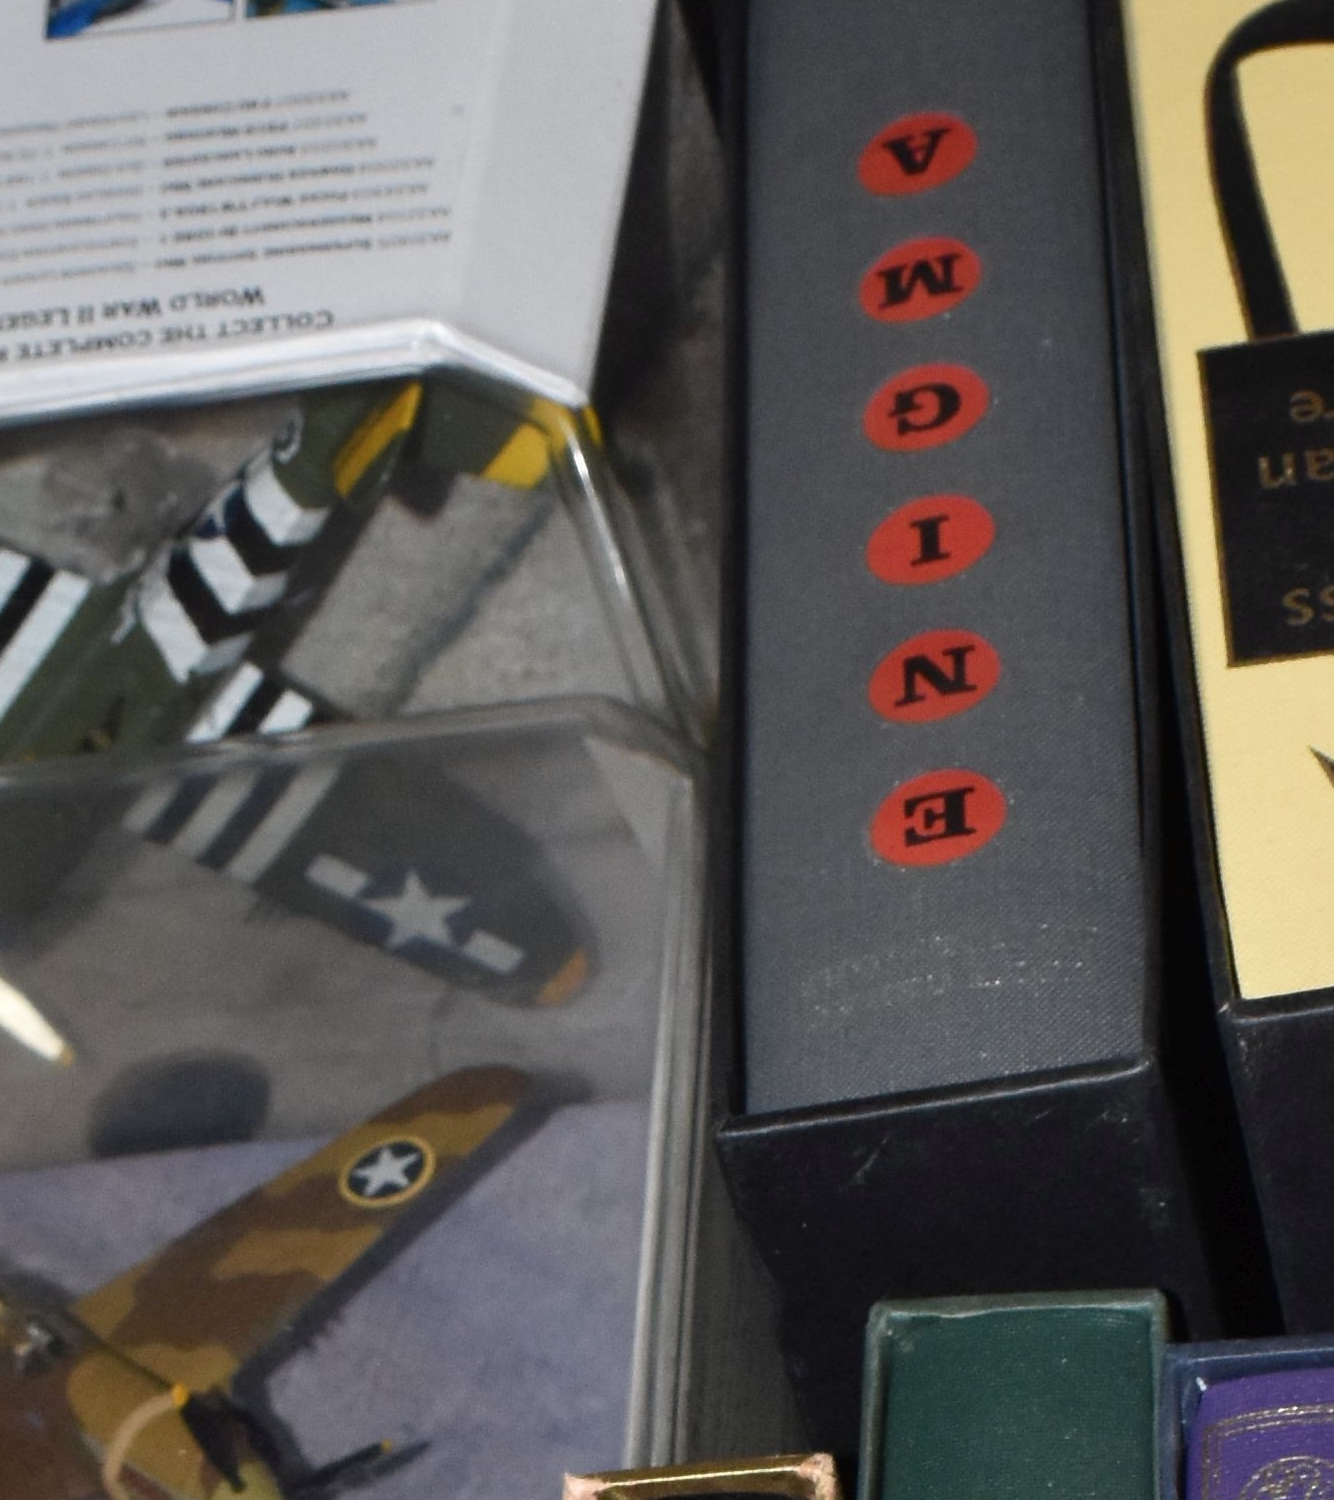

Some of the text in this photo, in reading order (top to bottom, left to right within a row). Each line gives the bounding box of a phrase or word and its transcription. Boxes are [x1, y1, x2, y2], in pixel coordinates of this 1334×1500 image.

[101, 297, 164, 321] WAR
[169, 284, 266, 312] WORLD
[159, 322, 209, 345] THE
[216, 307, 336, 338] COLLECT
[17, 328, 155, 363] COMPLETE
